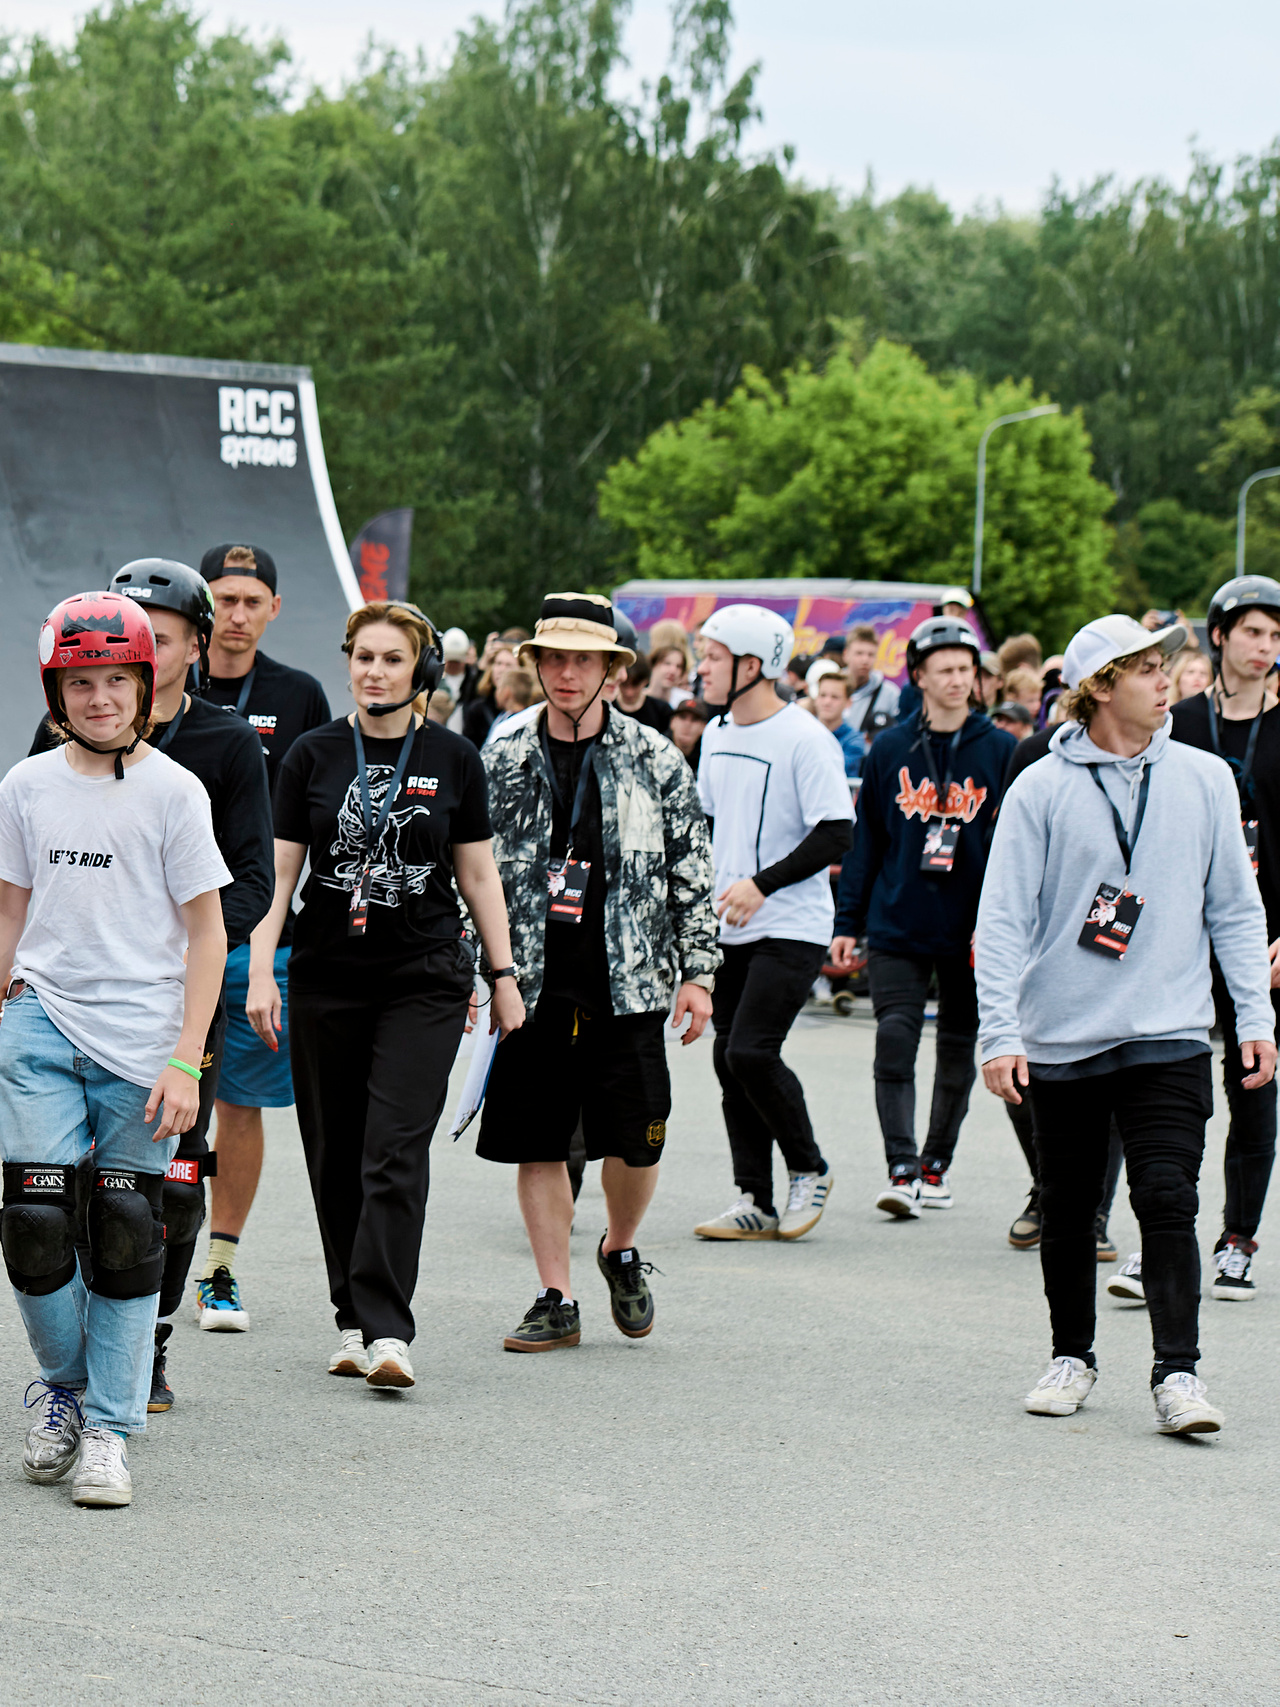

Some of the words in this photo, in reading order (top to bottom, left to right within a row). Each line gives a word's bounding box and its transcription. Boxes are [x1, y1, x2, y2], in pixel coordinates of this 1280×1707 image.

[218, 386, 296, 436] RCC
[112, 649, 142, 661] OATH
[248, 714, 278, 729] RCC
[407, 775, 439, 790] RCC
[79, 852, 113, 869] RIDE
[167, 1160, 194, 1181] ORE
[33, 1174, 65, 1187] GAIN
[103, 1177, 136, 1190] GAIN
